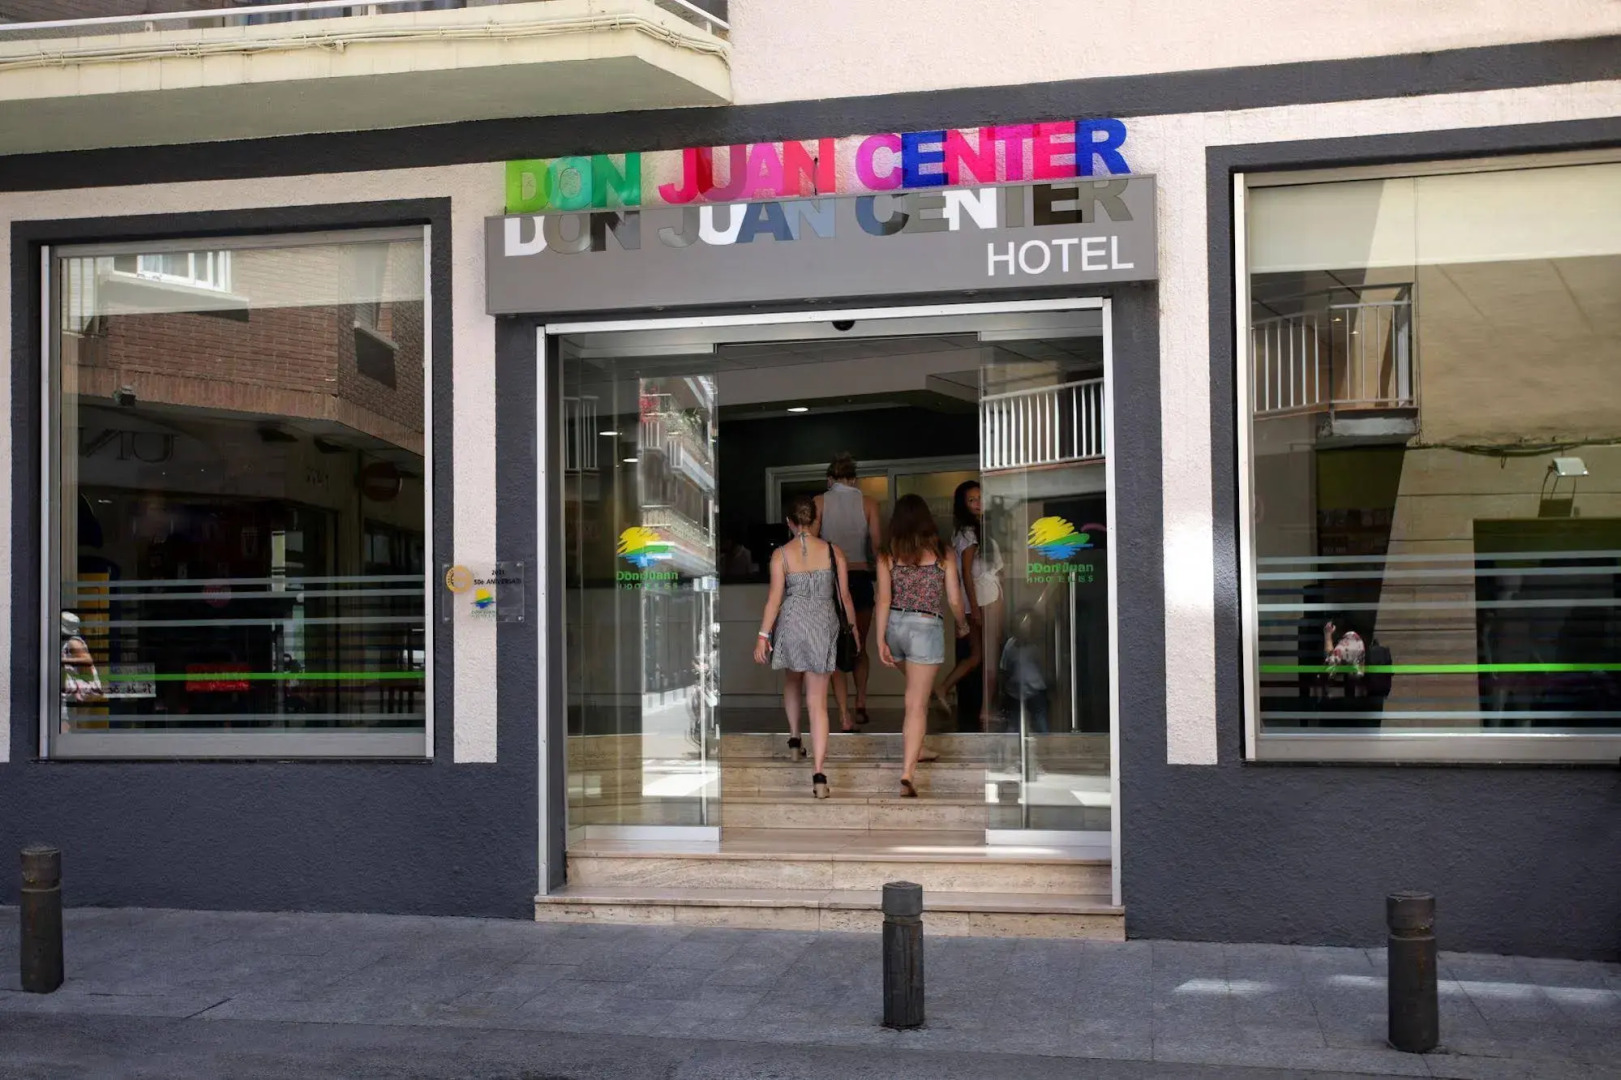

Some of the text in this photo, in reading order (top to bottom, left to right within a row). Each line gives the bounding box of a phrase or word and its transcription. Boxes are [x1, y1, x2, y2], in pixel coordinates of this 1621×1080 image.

[505, 118, 1132, 212] DON JUAN CENTER
[987, 235, 1135, 276] HOTEL
